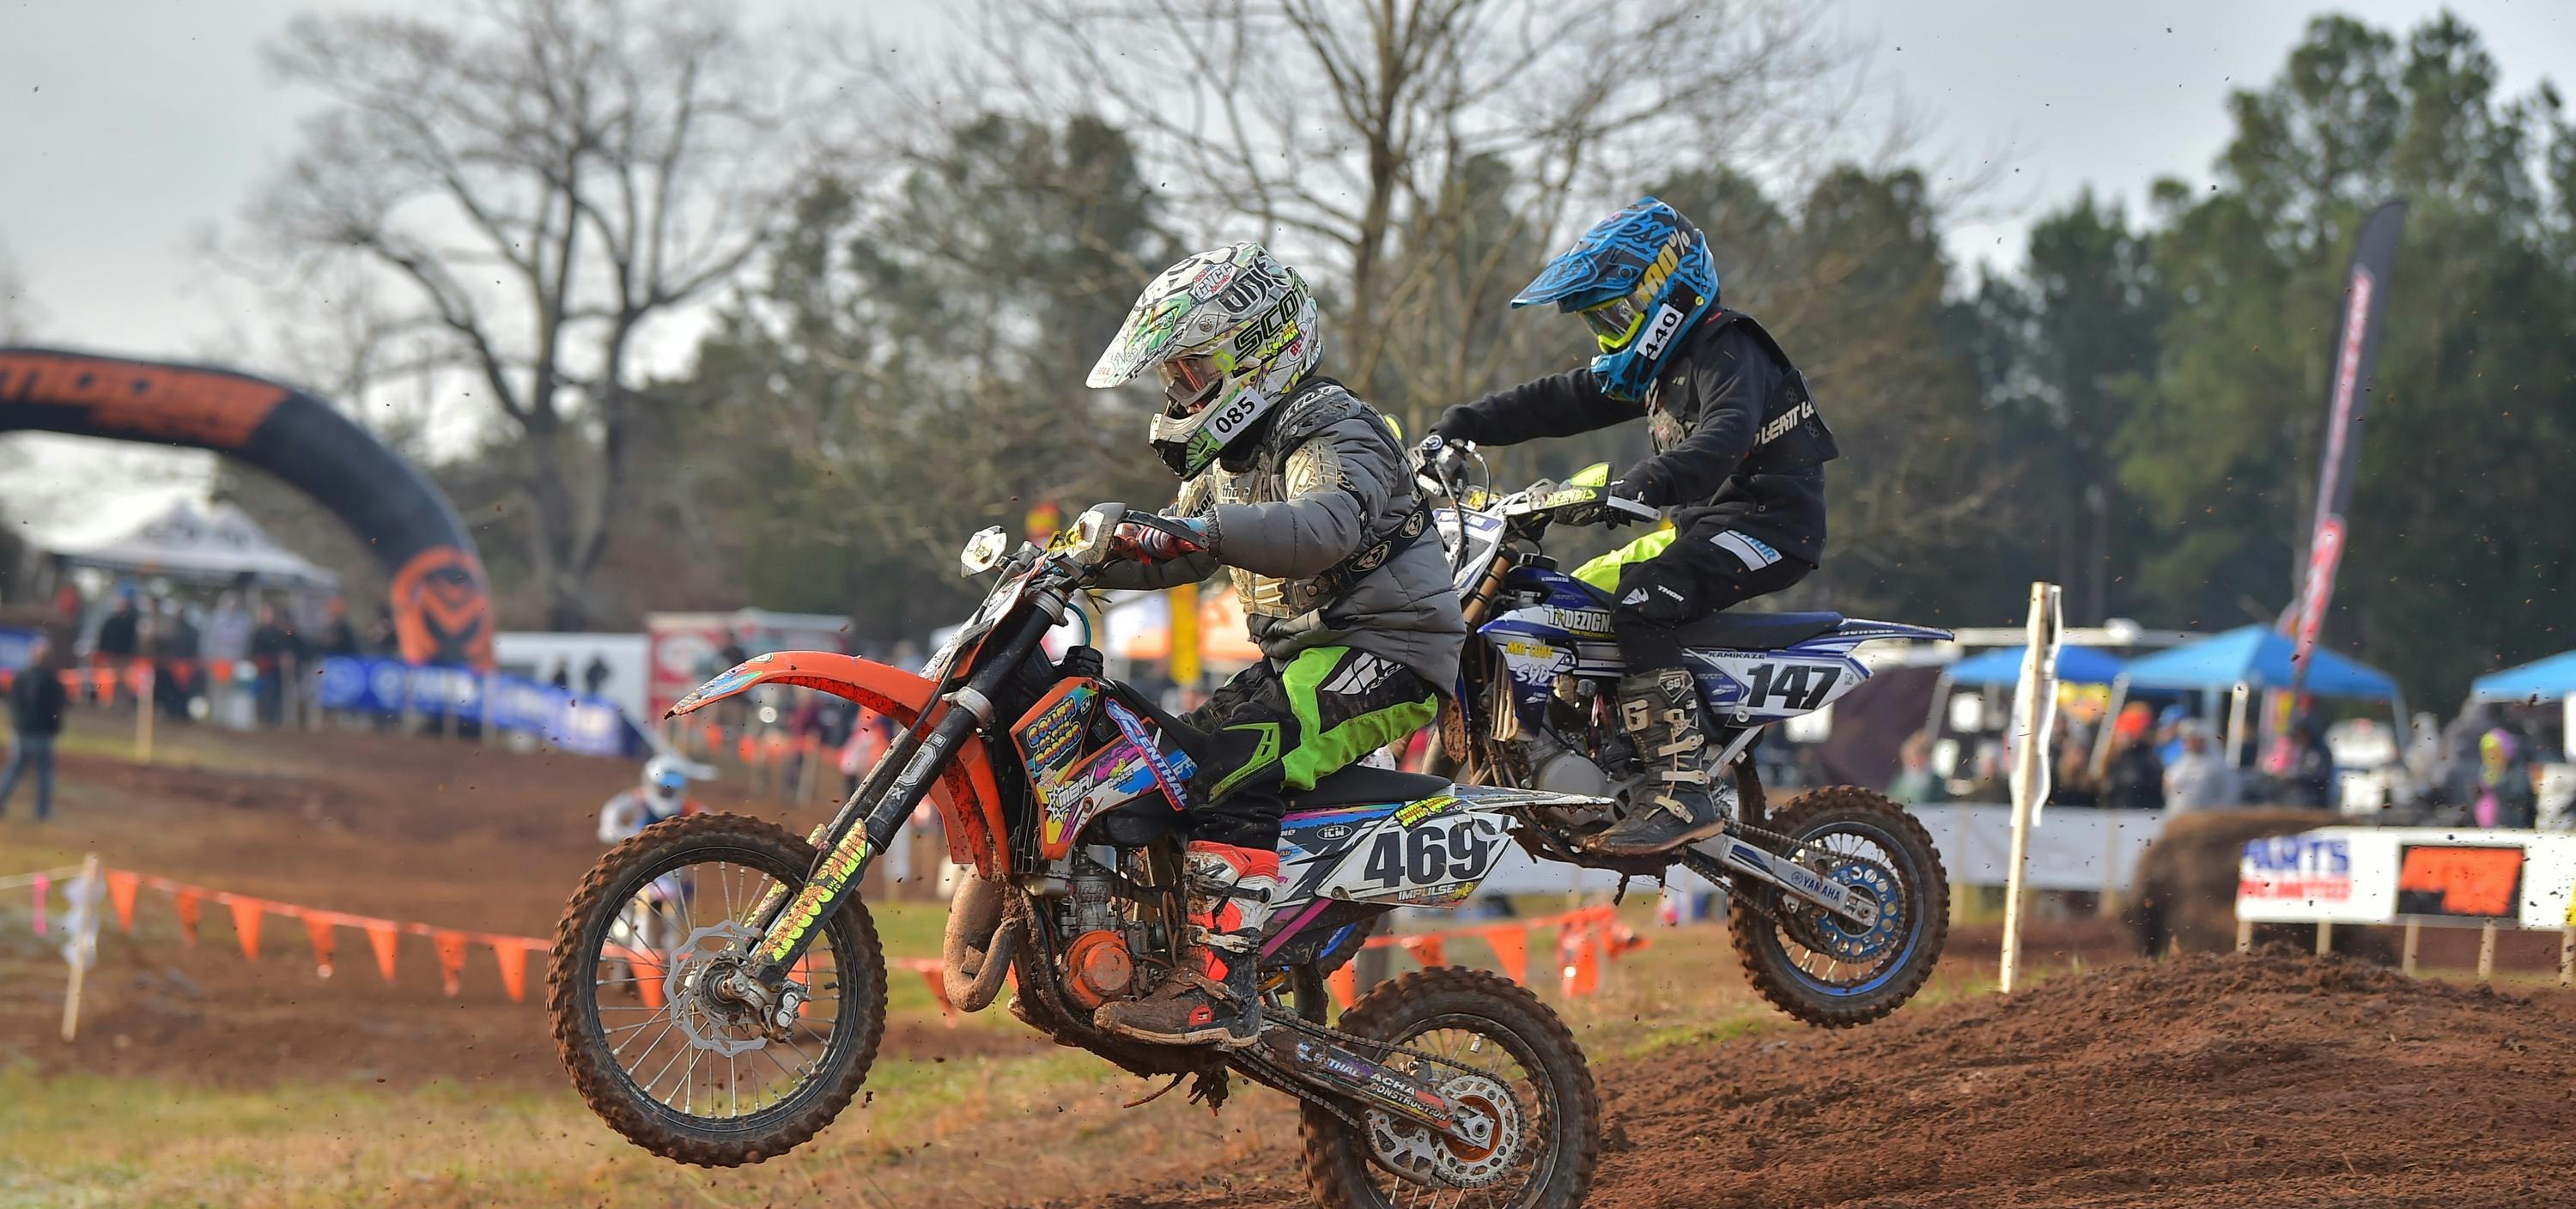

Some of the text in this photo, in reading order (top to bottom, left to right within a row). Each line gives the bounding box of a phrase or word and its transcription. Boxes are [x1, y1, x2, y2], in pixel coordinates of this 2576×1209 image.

[1195, 263, 1233, 299] GNCC
[1210, 275, 1231, 295] RACING
[1645, 313, 1678, 357] 440
[1214, 396, 1256, 434] 085
[1657, 584, 1685, 602] THOR
[1708, 651, 1766, 659] KAMIKAZE
[1746, 662, 1842, 710] 147
[1364, 819, 1493, 889] 469
[1398, 882, 1456, 901] IMPULSE
[1803, 876, 1841, 902] YAMAHA
[1370, 1072, 1416, 1096] ACHA
[1370, 1081, 1449, 1121] CONSTRUCTION
